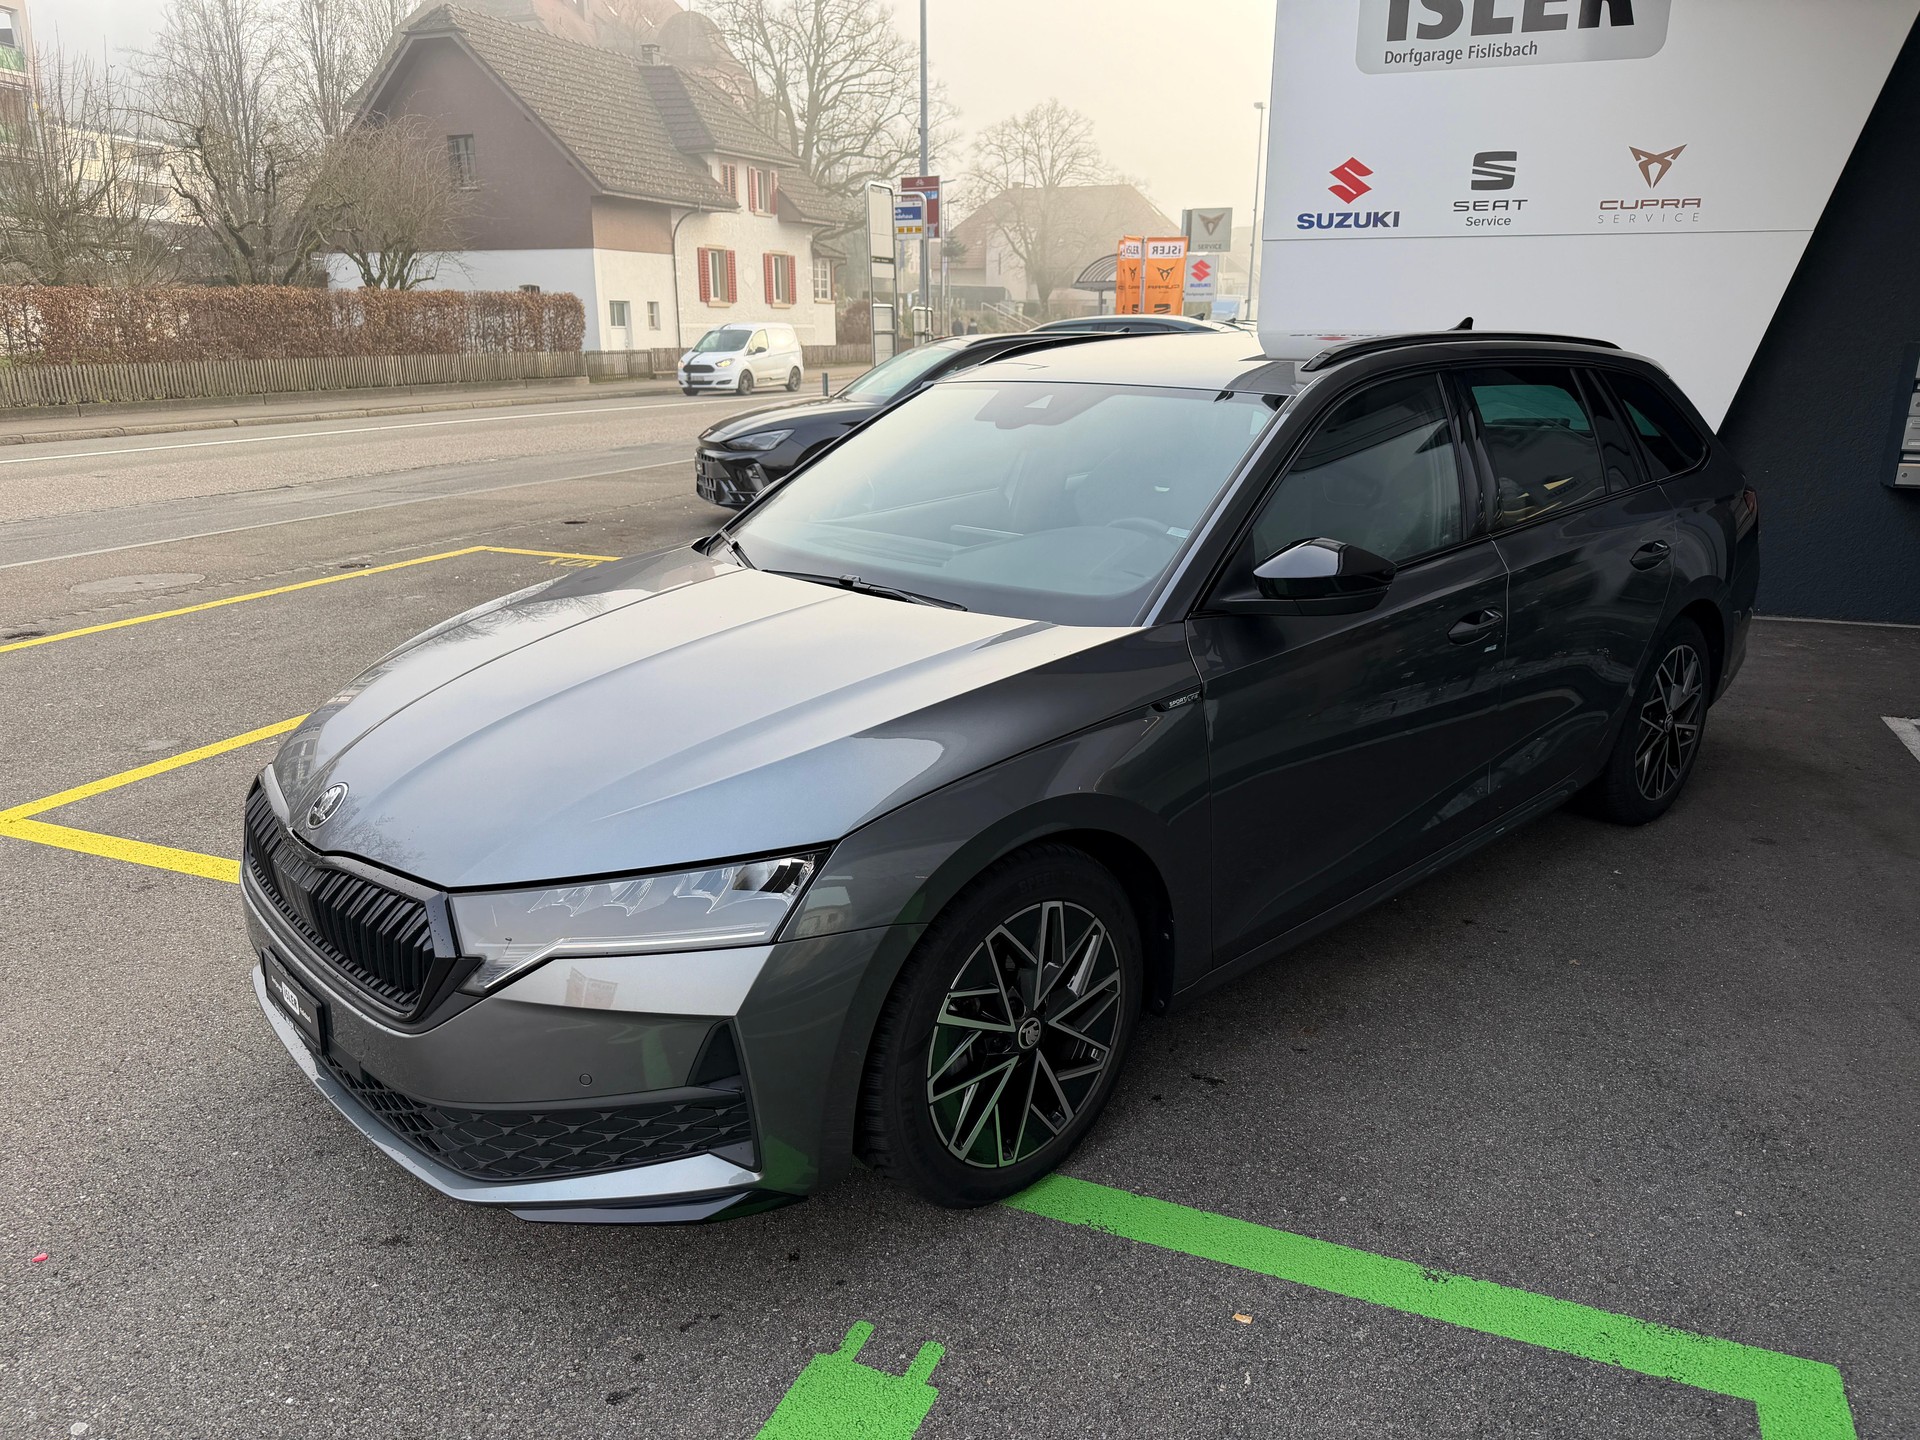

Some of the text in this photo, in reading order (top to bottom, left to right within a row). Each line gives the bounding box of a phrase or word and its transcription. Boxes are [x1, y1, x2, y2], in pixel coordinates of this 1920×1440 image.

[1384, 41, 1538, 66] Dorfgarage Fislisbach
[1453, 199, 1528, 212] SEAT
[1600, 198, 1702, 210] CUPRA
[1296, 211, 1400, 230] SUZUKI
[1465, 215, 1512, 227] Service
[1597, 212, 1700, 224] SERVICE
